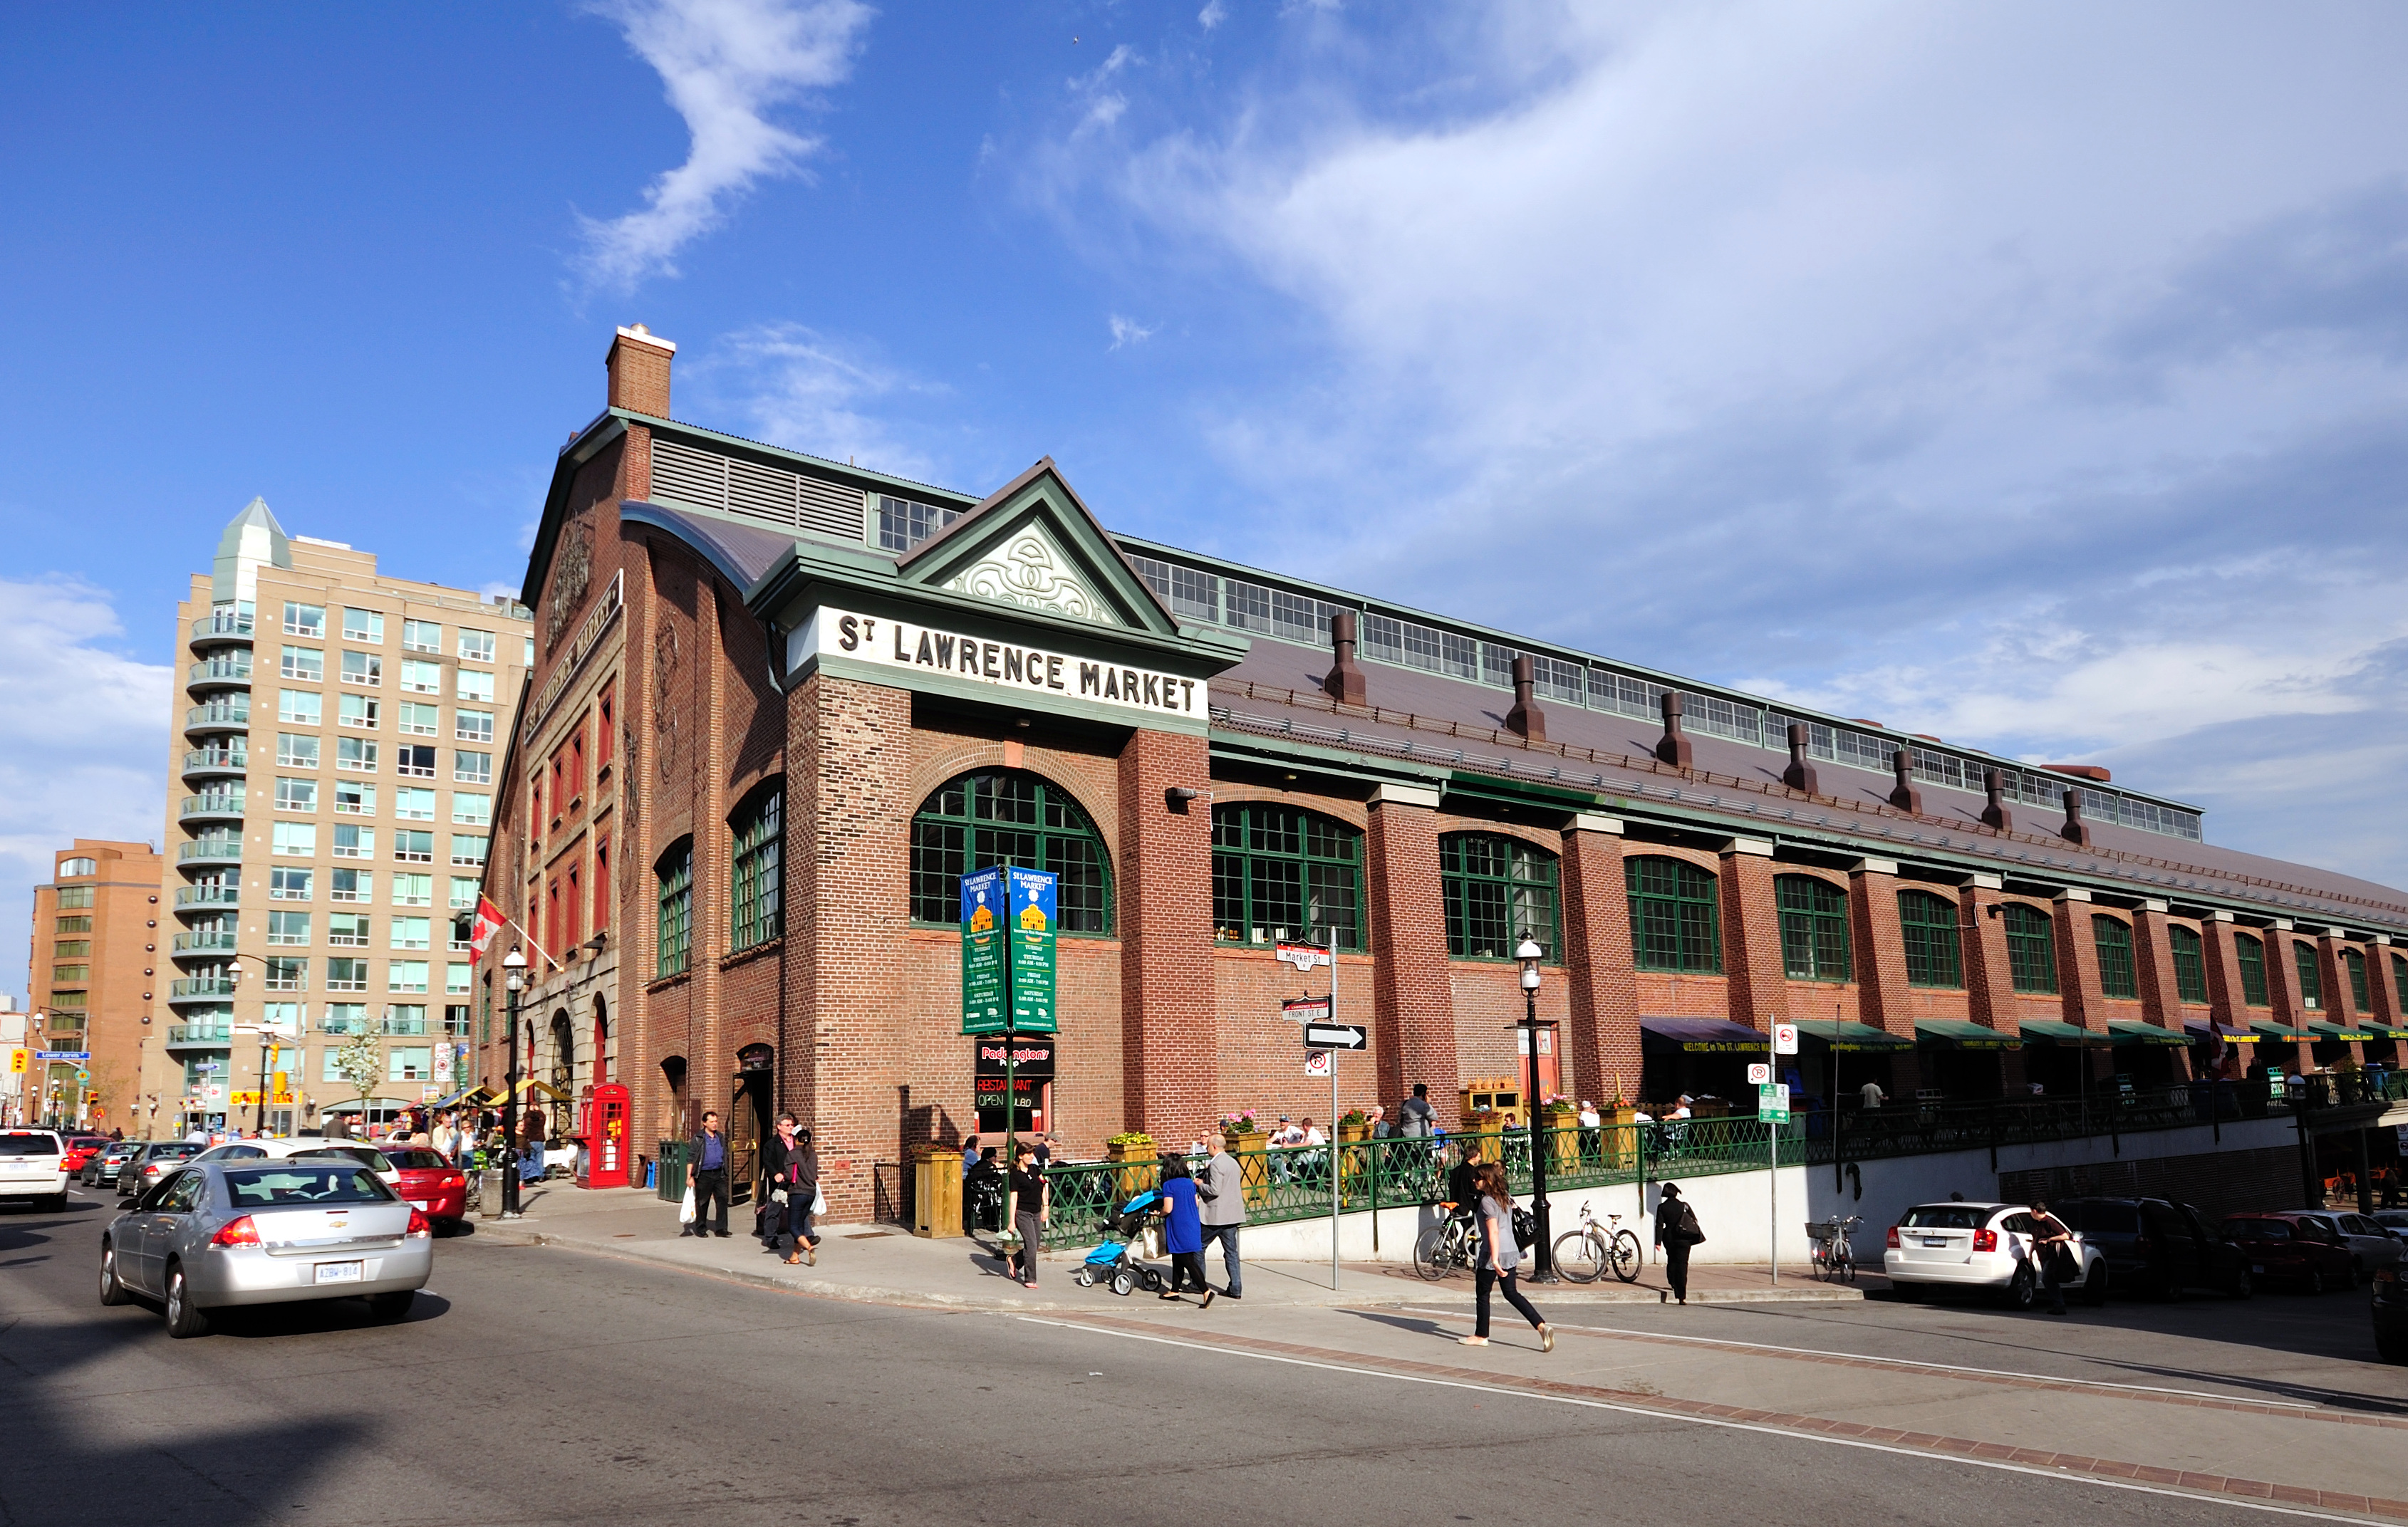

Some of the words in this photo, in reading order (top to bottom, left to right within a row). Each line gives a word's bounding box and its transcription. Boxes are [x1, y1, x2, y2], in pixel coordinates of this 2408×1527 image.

[539, 651, 572, 719] LAWRENCE
[576, 590, 612, 662] MARKET
[895, 625, 1064, 689] LAWRENCE
[1080, 662, 1195, 712] MARKET
[1019, 872, 1053, 885] LAWRENCE
[970, 881, 991, 892] MARKET
[1020, 880, 1046, 891] MARKET
[1286, 952, 1311, 963] Market
[1313, 954, 1321, 964] St
[1683, 1042, 1710, 1052] WELCOME
[1735, 1042, 1760, 1052] LAWRENCE
[978, 1094, 1004, 1106] OPEN
